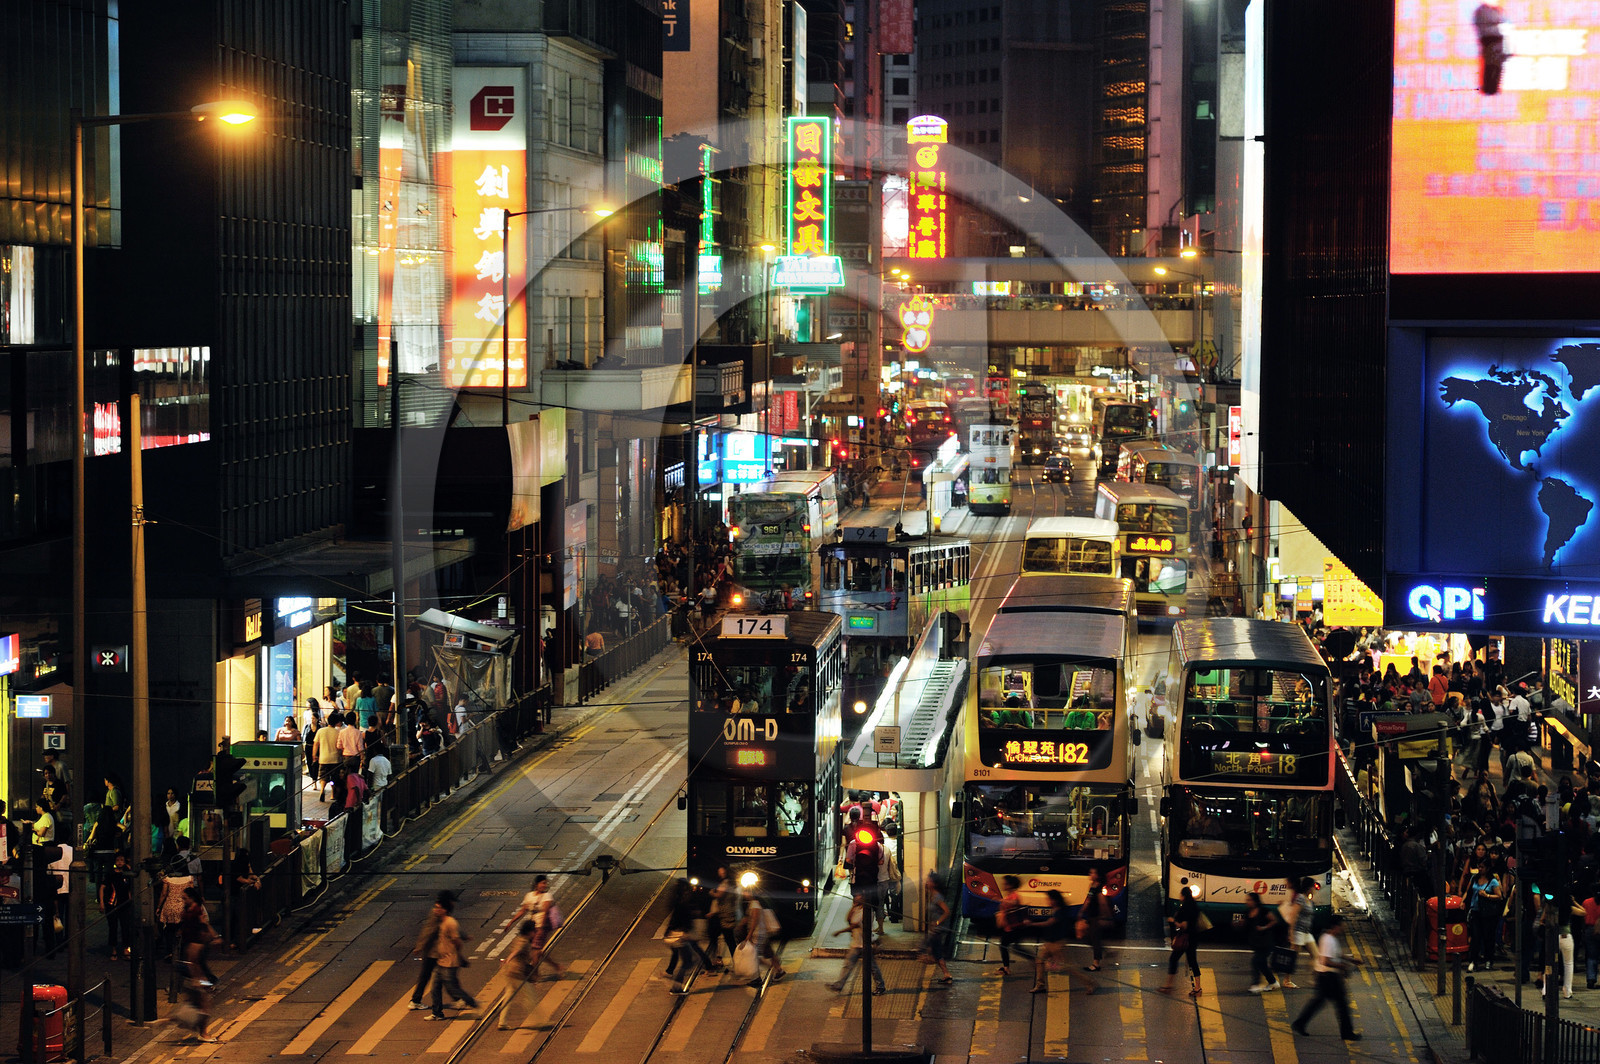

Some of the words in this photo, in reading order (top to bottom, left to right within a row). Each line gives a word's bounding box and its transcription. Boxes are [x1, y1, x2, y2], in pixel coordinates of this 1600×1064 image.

[792, 122, 827, 255] 日發文具
[1502, 414, 1528, 423] Chicago
[1516, 429, 1530, 437] New
[1532, 429, 1546, 437] York
[763, 526, 779, 534] 960
[856, 528, 878, 541] 94
[890, 551, 900, 560] 94
[736, 618, 773, 636] 174
[697, 652, 714, 662] 174
[790, 652, 808, 663] 174
[723, 717, 779, 742] OM-D
[1006, 740, 1055, 755] 愉翠苑
[1059, 742, 1090, 764] 182
[1225, 752, 1262, 766] 北角
[1278, 754, 1296, 775] 18
[973, 769, 991, 777] 8101
[1214, 763, 1243, 774] North
[1247, 763, 1273, 774] Point
[725, 845, 778, 855] OLYMPUS
[795, 901, 809, 911] 174
